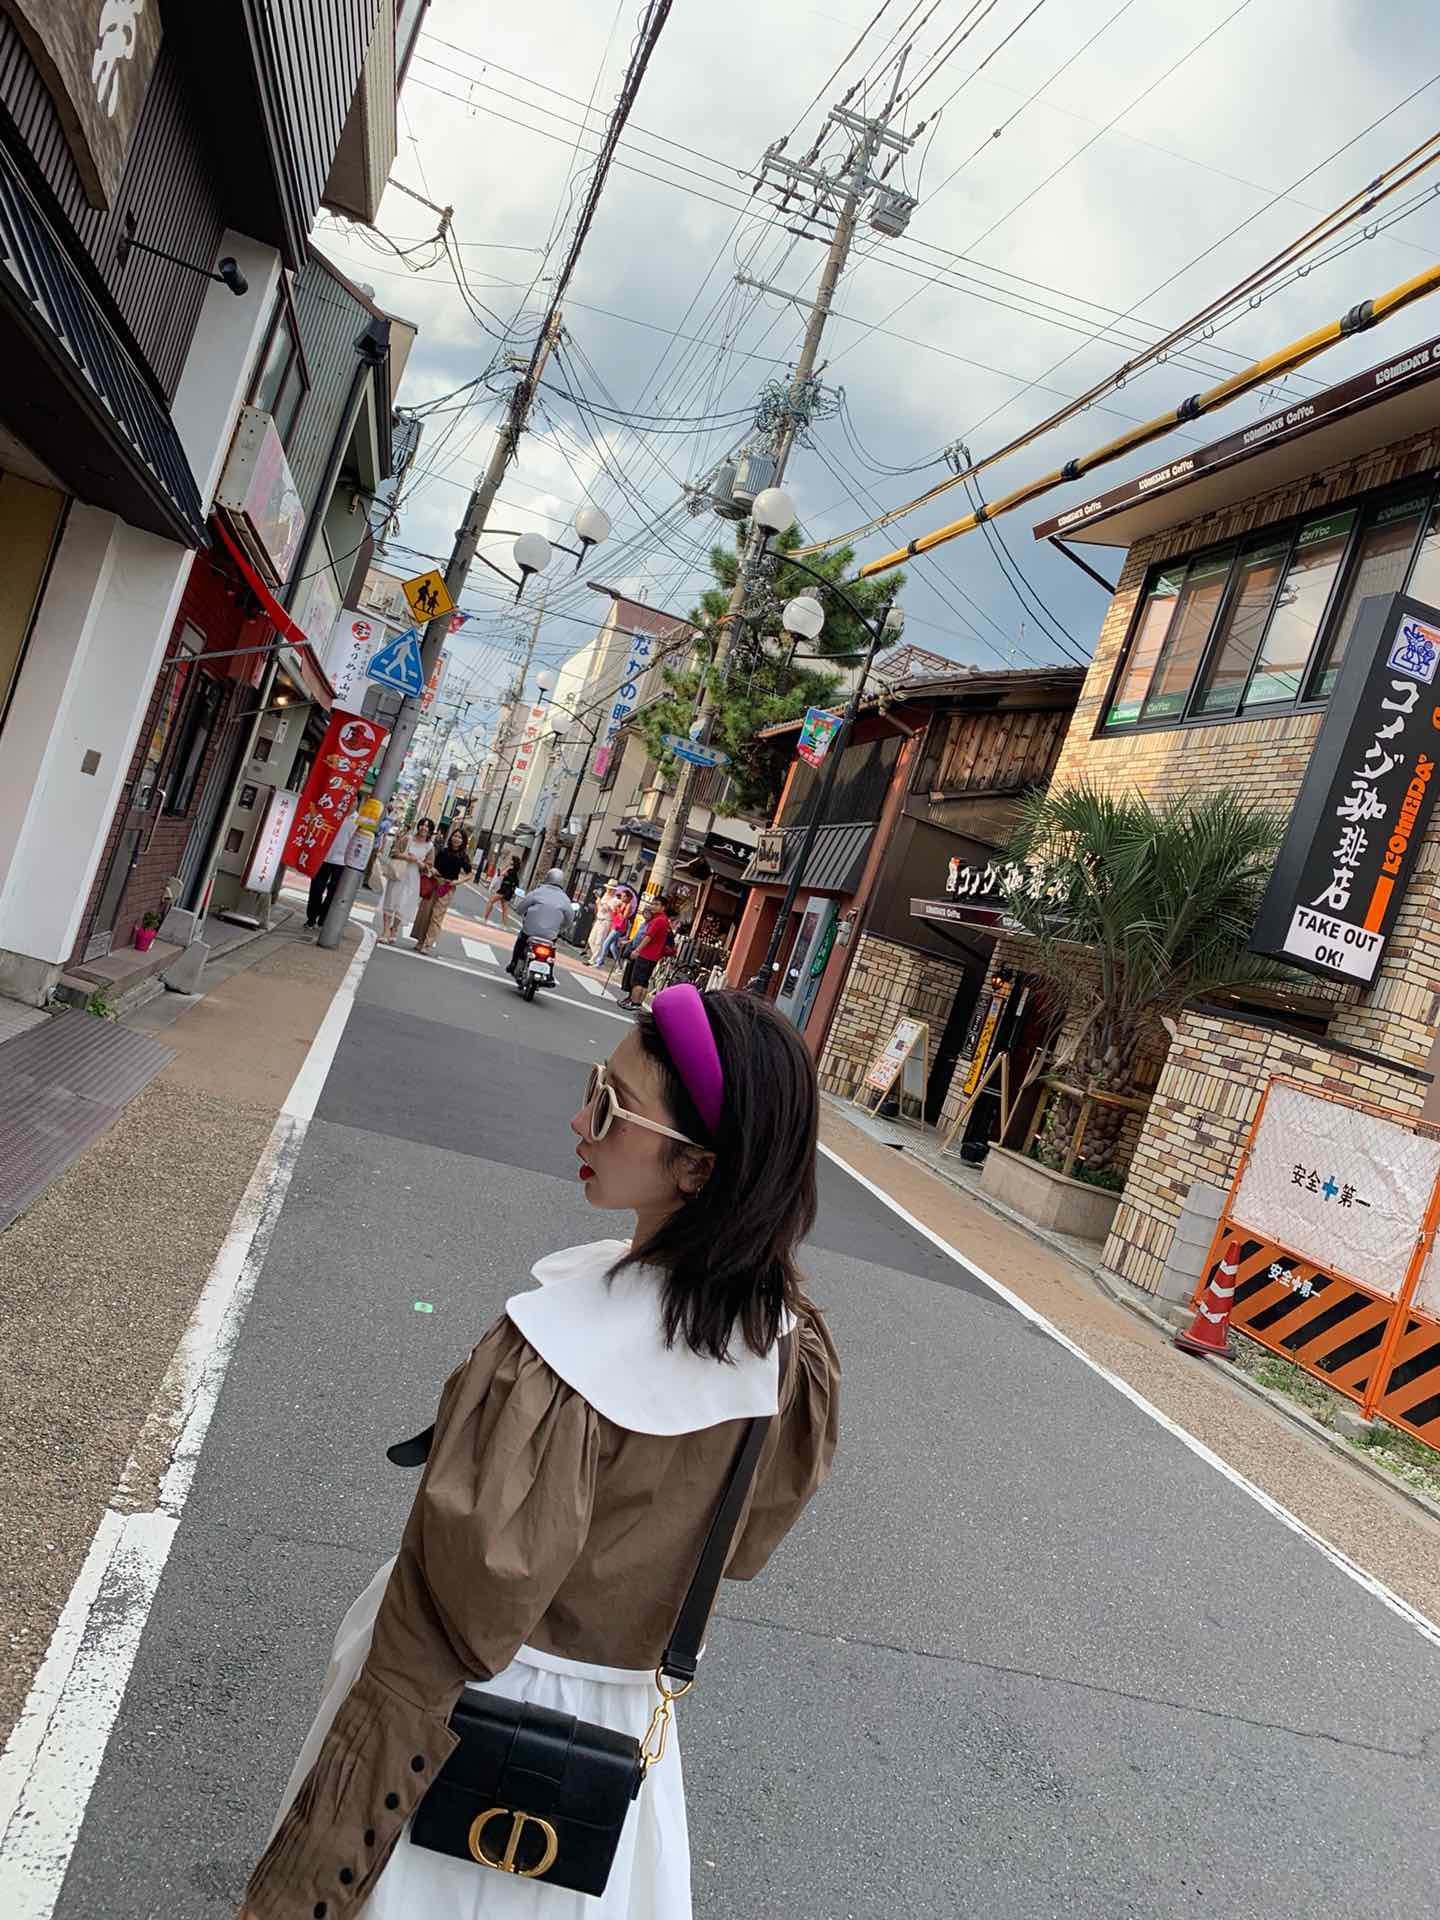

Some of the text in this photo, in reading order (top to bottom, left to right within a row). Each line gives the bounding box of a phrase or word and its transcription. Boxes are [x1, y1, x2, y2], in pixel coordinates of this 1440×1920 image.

[1310, 679, 1420, 910] コメダ珈琲店
[1299, 911, 1379, 952] TAKE OUT
[1315, 945, 1345, 968] OK!
